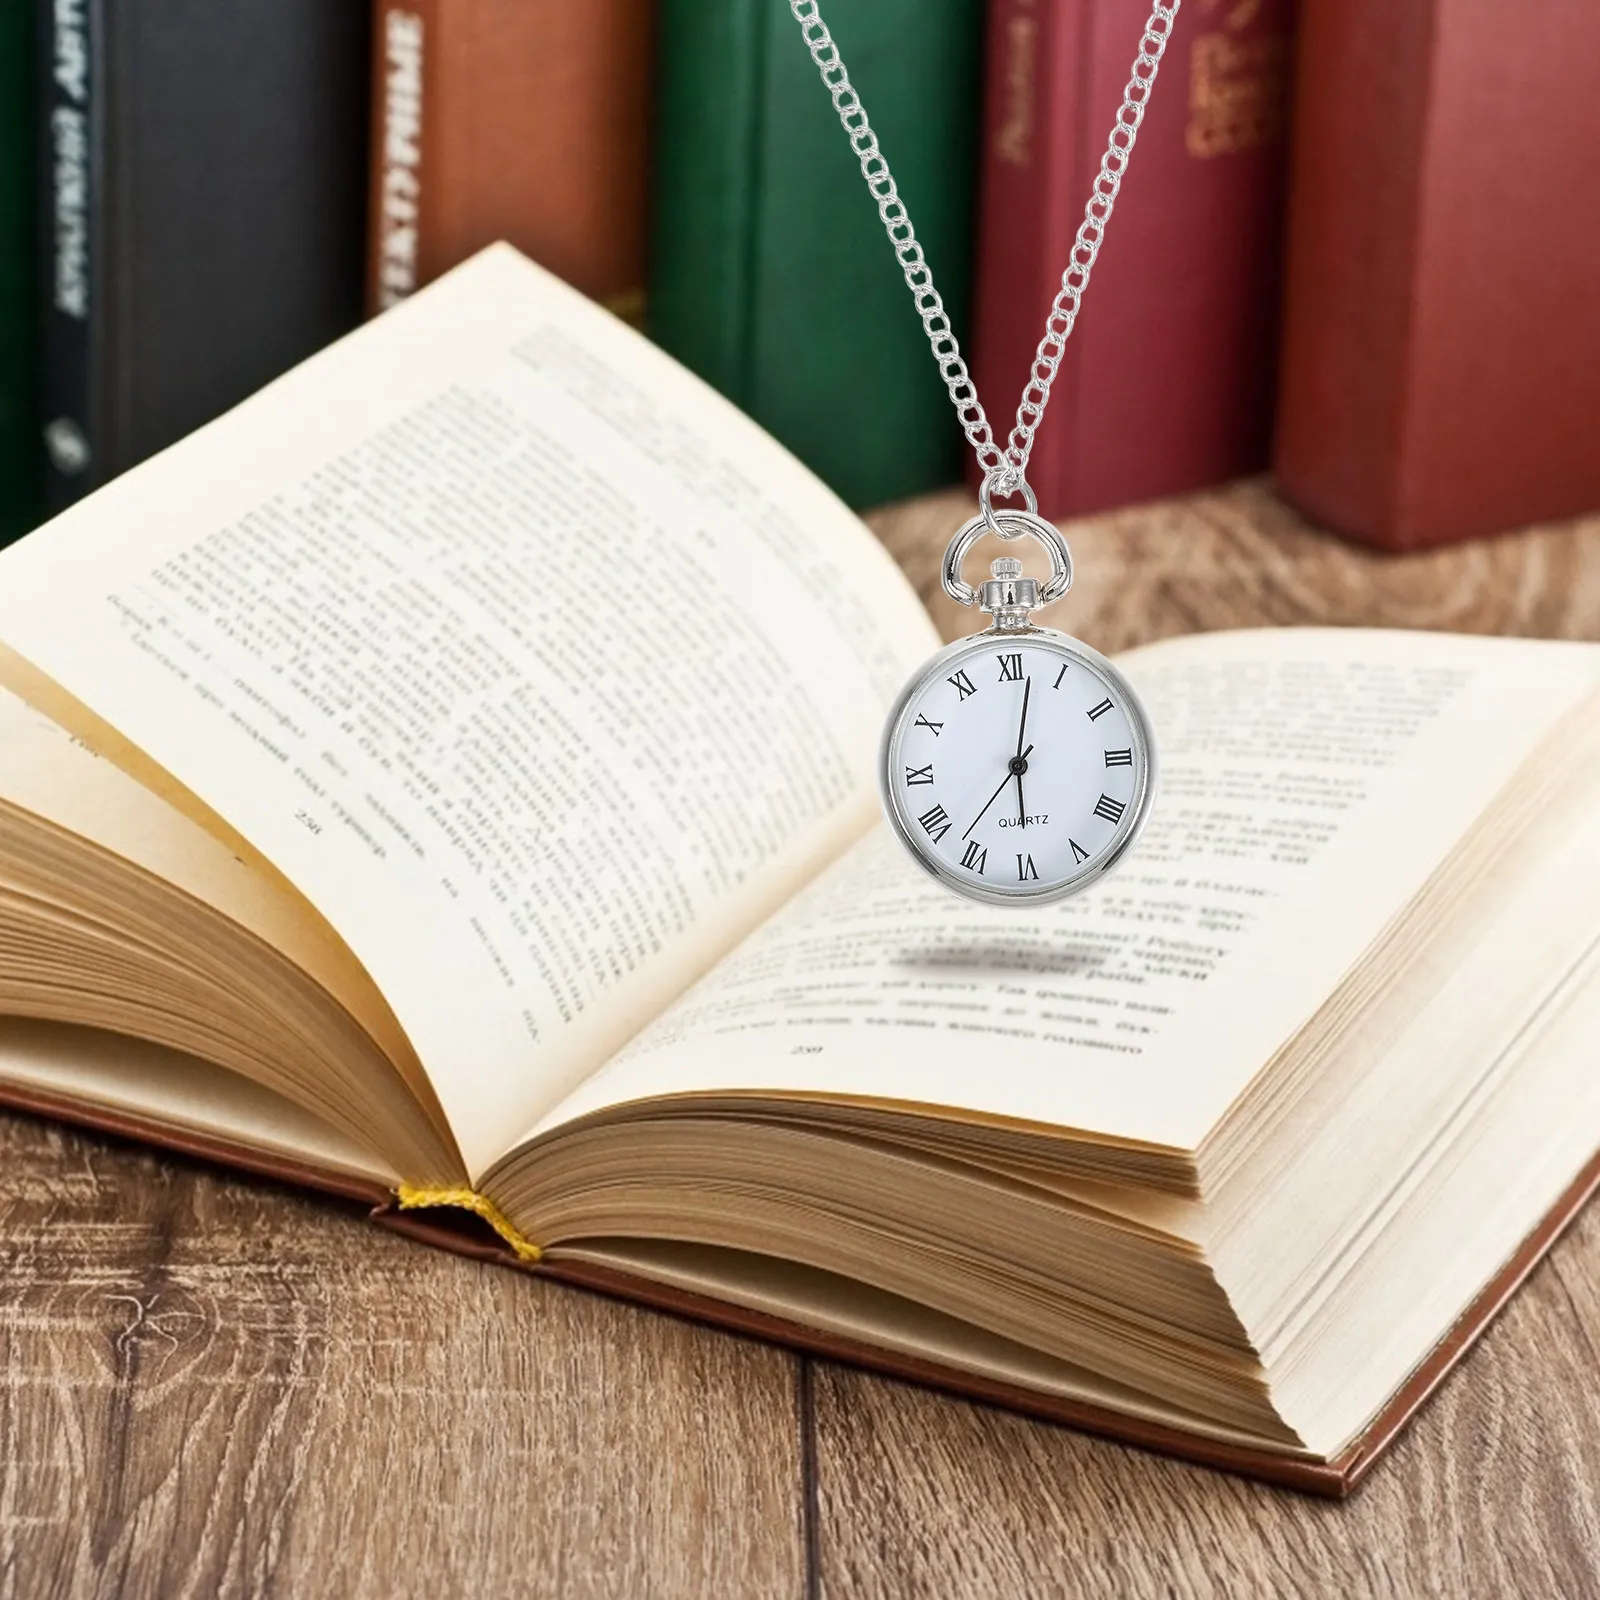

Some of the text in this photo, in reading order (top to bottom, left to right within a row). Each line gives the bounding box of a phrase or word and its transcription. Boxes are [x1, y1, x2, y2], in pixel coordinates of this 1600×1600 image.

[996, 653, 1025, 682] XII
[1052, 663, 1069, 690] I
[946, 668, 978, 702] XI
[1086, 697, 1115, 722] II
[914, 712, 944, 737] X
[905, 763, 934, 787] IX
[1067, 837, 1091, 865] V
[1016, 853, 1039, 881] VI
